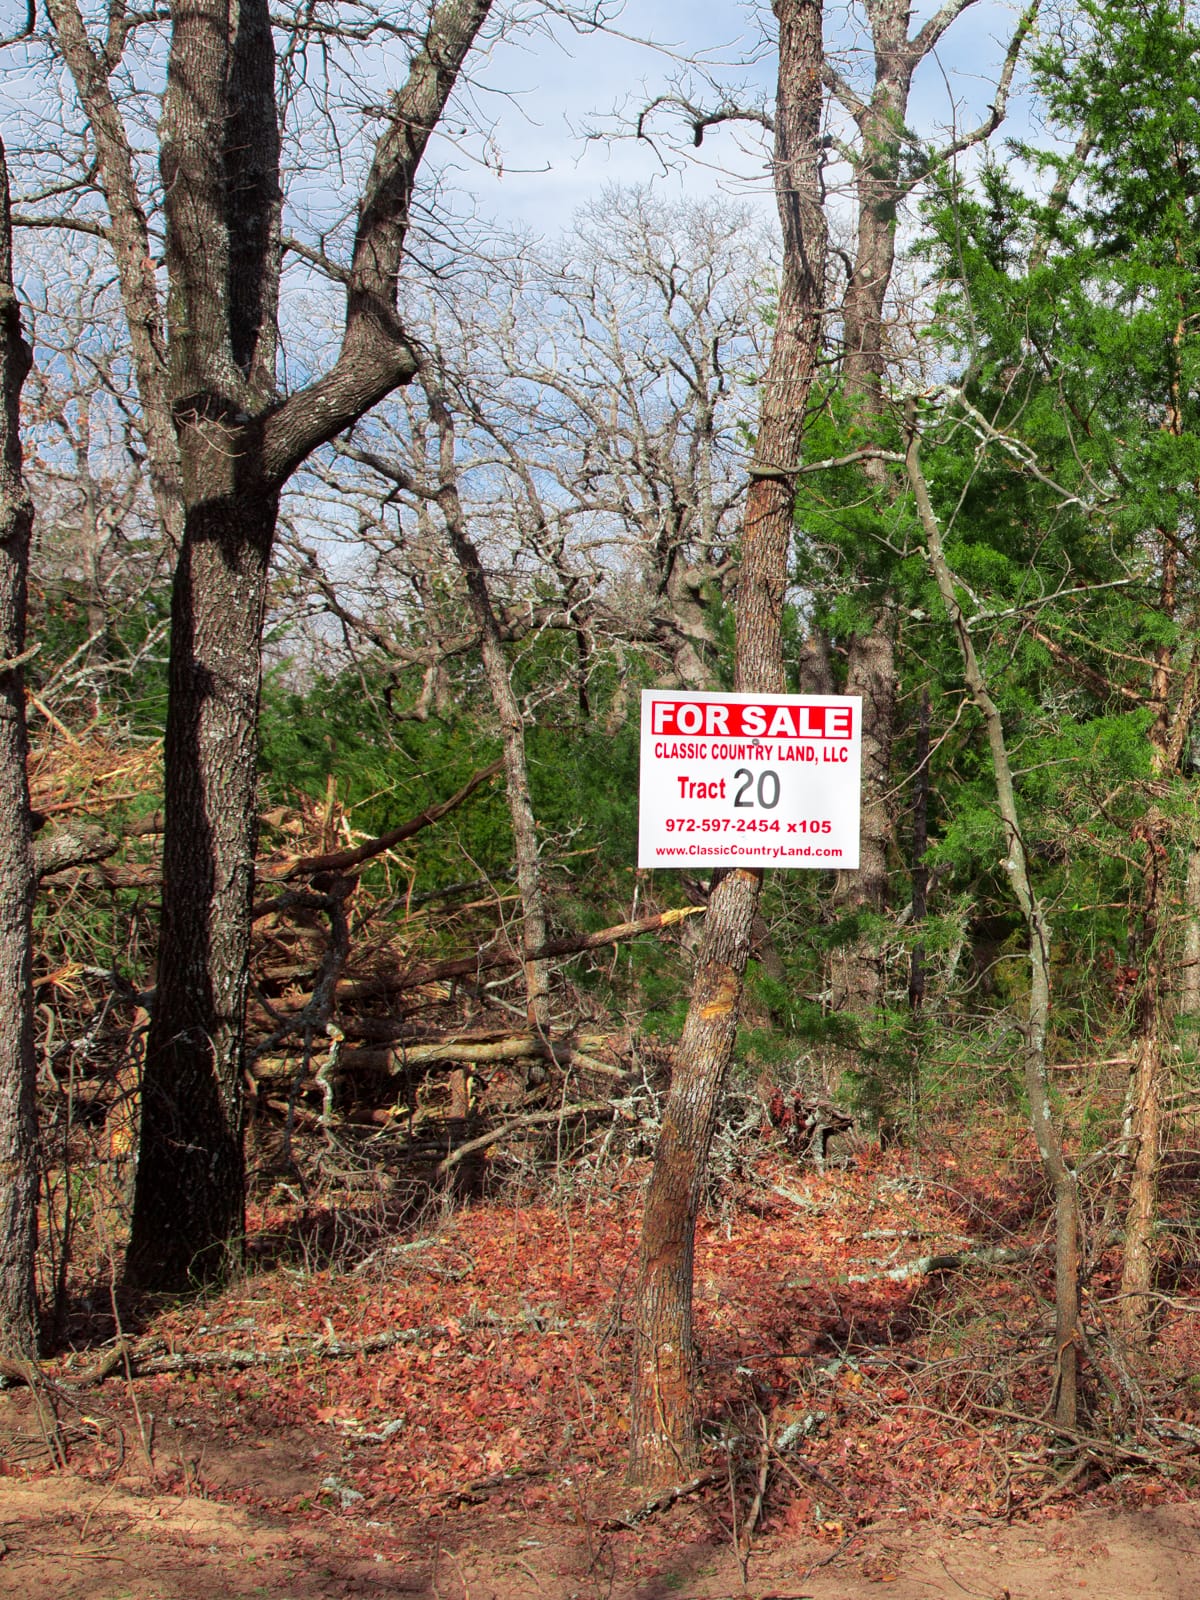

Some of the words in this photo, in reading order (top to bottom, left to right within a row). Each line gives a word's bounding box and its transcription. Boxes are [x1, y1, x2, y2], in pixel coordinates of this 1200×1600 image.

[654, 703, 730, 735] FOR
[741, 705, 849, 738] SALE
[654, 742, 707, 759] CLASSIC
[711, 743, 773, 761] COUNTRY
[778, 746, 819, 765] LAND,
[823, 746, 848, 763] LLC
[677, 776, 726, 799] Tract
[733, 767, 781, 809] 20
[665, 818, 780, 832] 972-597-2454
[786, 820, 832, 833] x105
[655, 844, 843, 858] www.ClassicCountryLand.com
